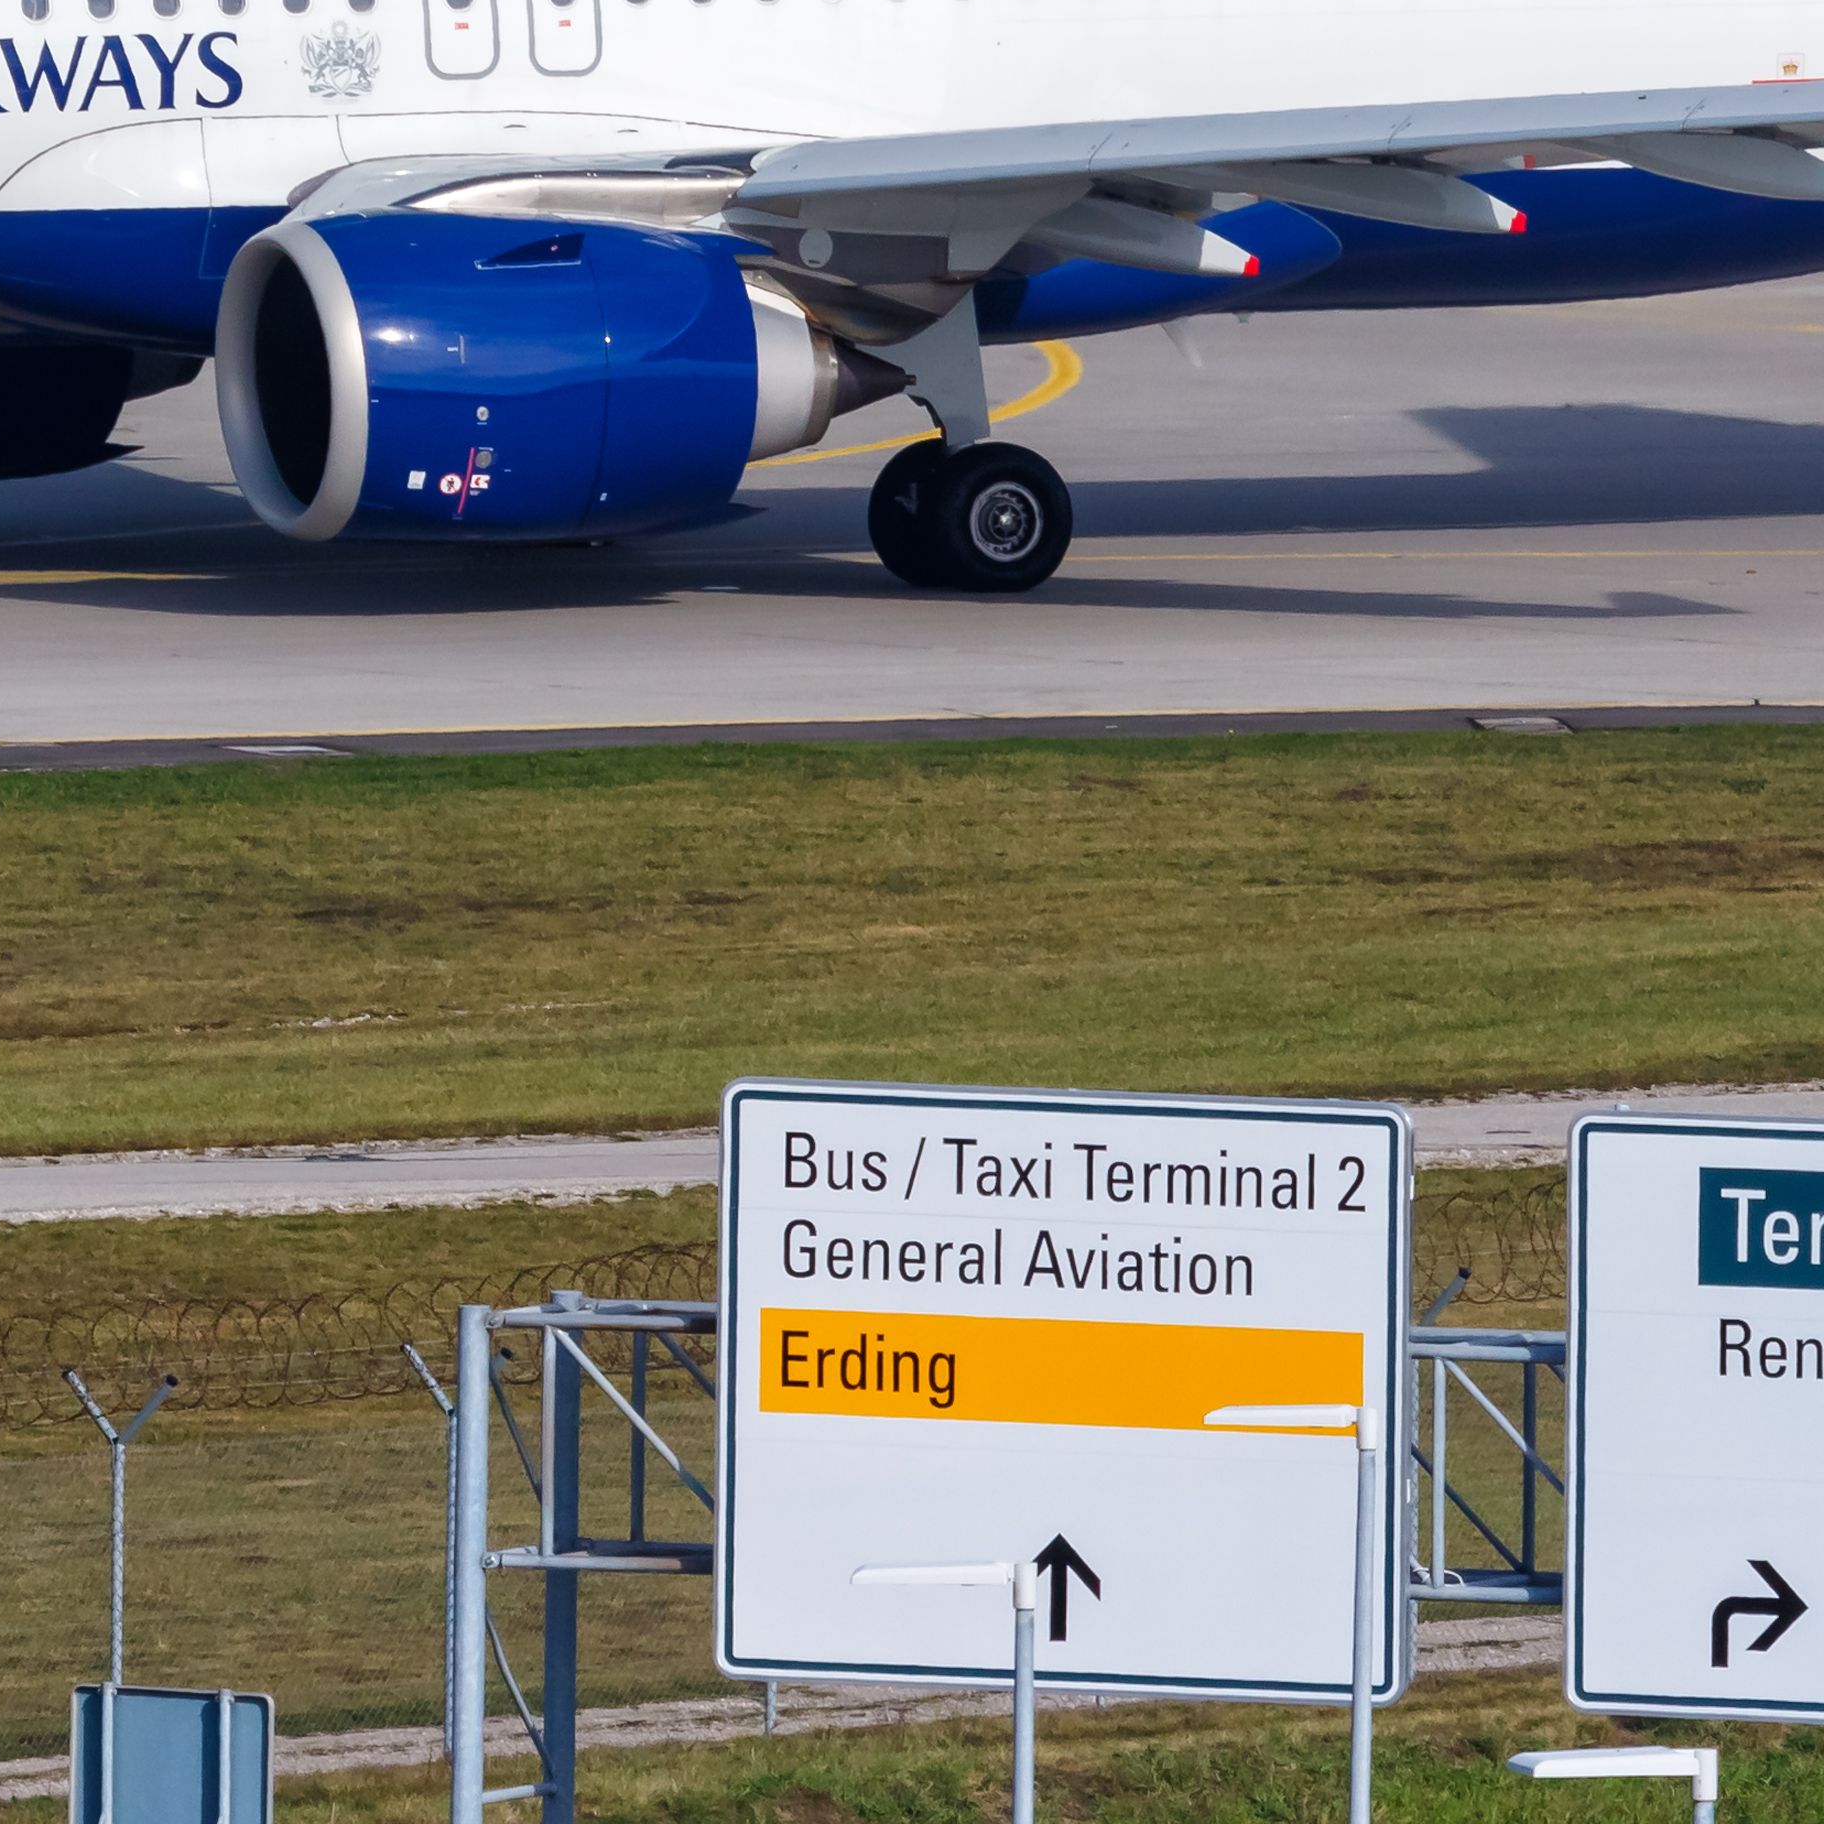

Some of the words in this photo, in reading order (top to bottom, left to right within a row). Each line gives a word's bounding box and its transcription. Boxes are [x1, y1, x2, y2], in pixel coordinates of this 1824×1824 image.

[784, 1131, 887, 1192] Bus
[904, 1137, 926, 1200] /
[942, 1137, 1052, 1199] Taxi
[1073, 1143, 1315, 1210] Terminal
[1337, 1156, 1366, 1212] 2
[783, 1219, 1002, 1285] General
[1023, 1229, 1253, 1296] Aviation
[781, 1330, 956, 1409] Erding
